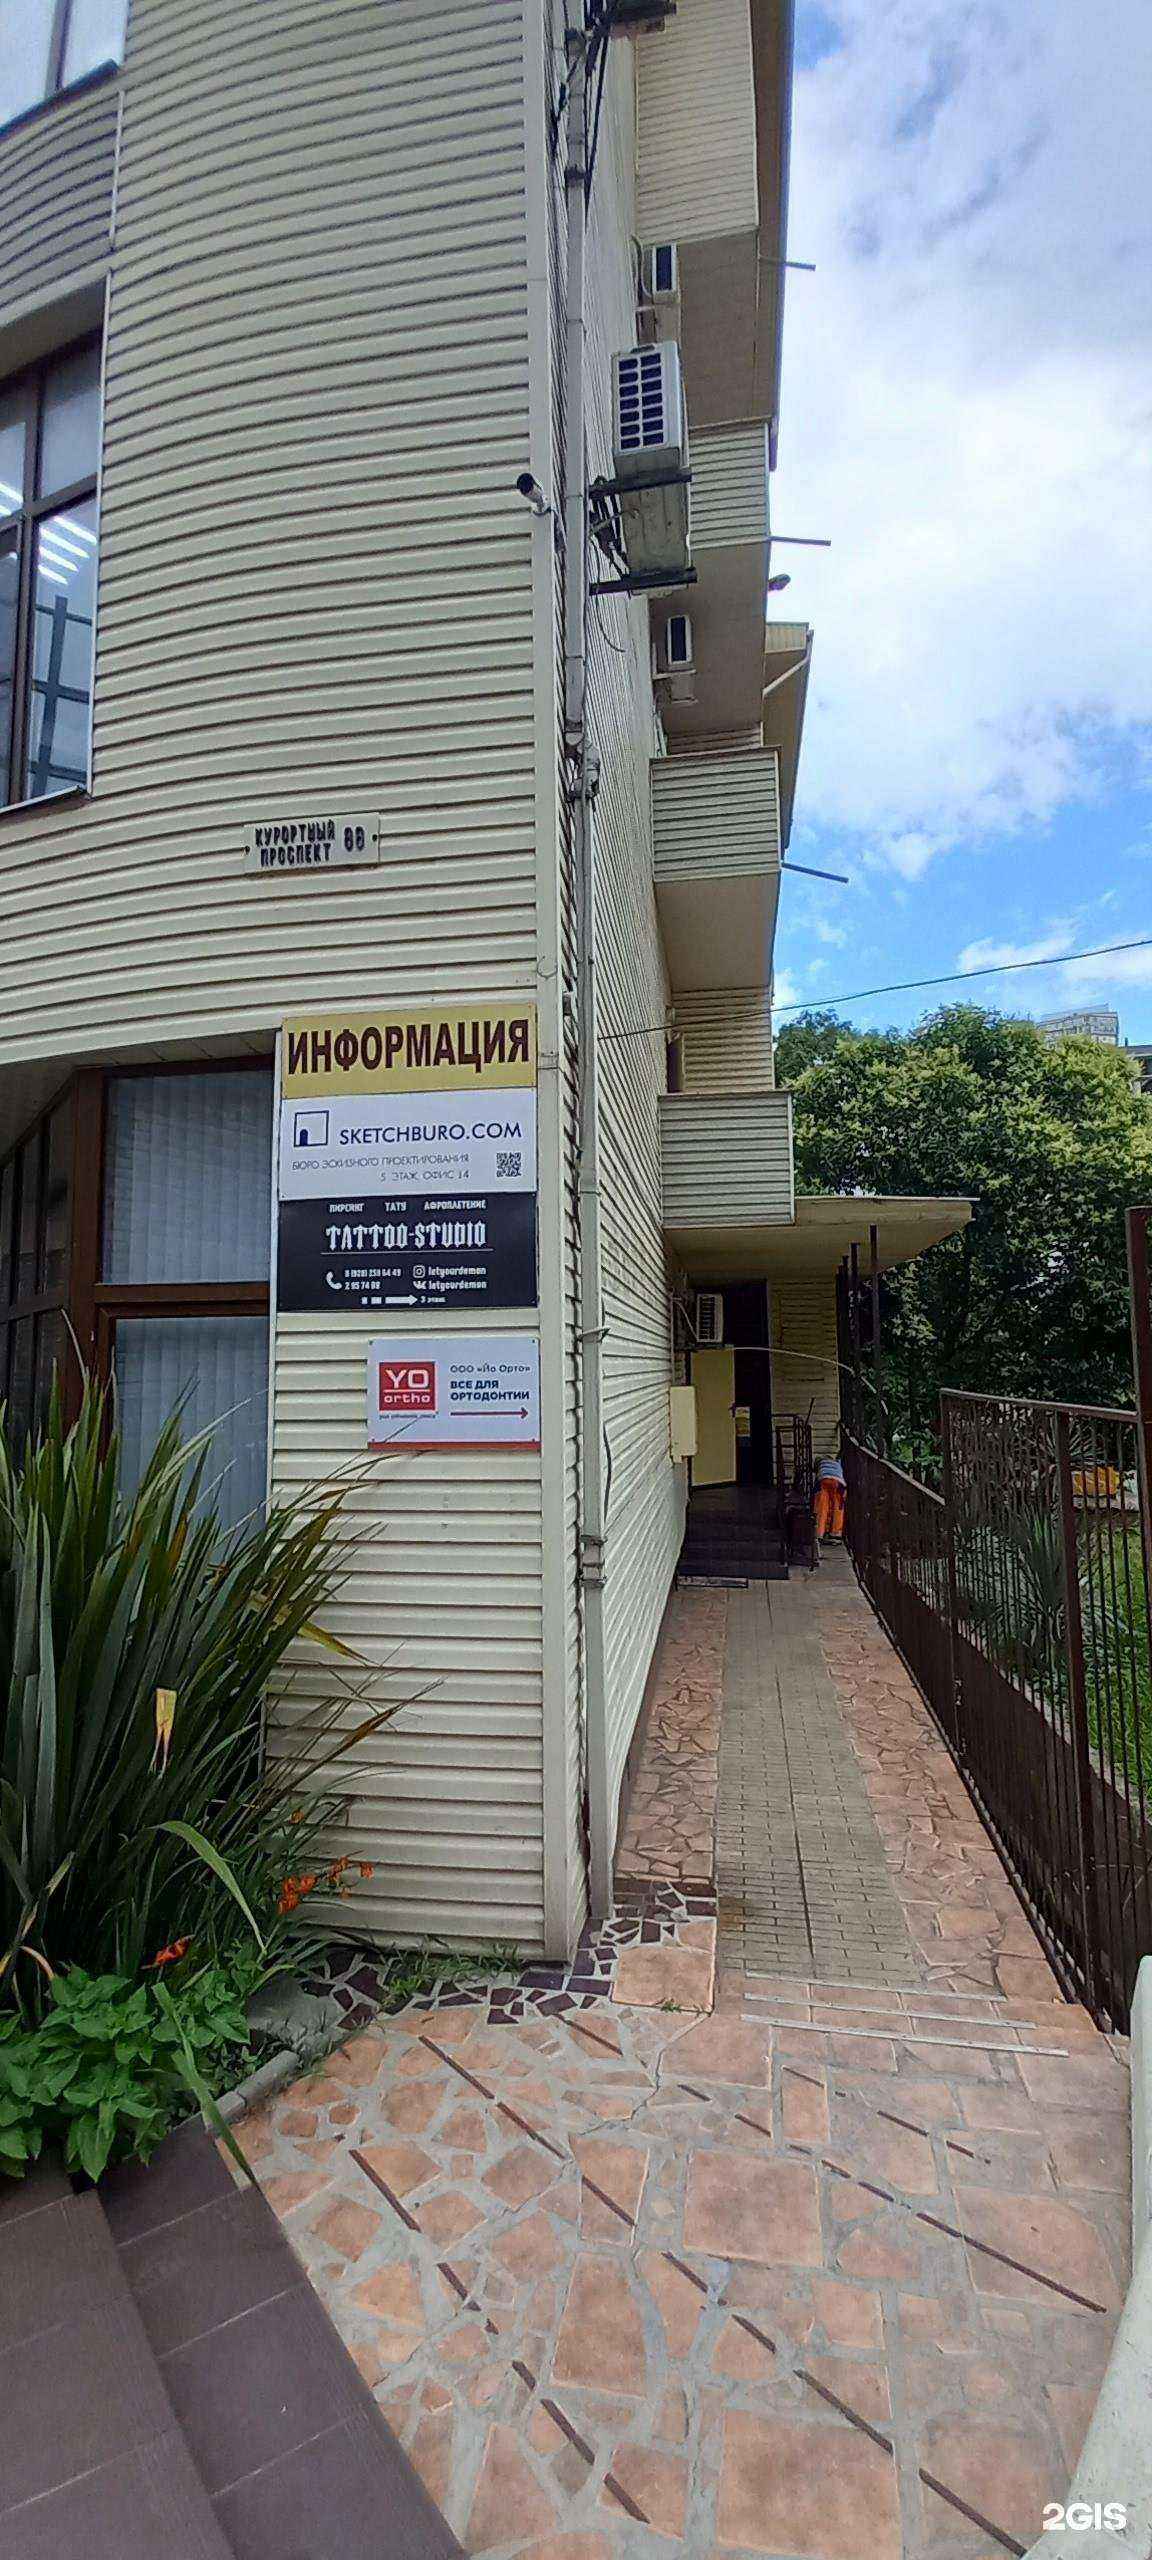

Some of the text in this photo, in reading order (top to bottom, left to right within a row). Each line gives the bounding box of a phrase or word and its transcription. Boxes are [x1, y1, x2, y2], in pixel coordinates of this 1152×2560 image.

[255, 819, 336, 847] КУРОРТНЫЙ
[260, 843, 331, 867] ПРОСПЕКТ
[288, 1018, 530, 1075] ИНФОРМАЦИЯ
[339, 1122, 522, 1146] SKETCHBURO.COM
[292, 1153, 469, 1171] БЮРО ЭСКИЗНОГО ПРОЕКТИРОВАНИЯ
[423, 1170, 454, 1180] ОФИС
[458, 1170, 469, 1179] 14
[329, 1203, 364, 1213] ПИРСИНГ
[385, 1202, 406, 1212] ТАТУ
[325, 1220, 487, 1250] TATTOO-STUDIO
[450, 1364, 474, 1373] ООО
[499, 1364, 531, 1374] Орто»
[385, 1369, 430, 1389] YO
[450, 1380, 499, 1390] ВСЕ ДЛЯ
[383, 1392, 432, 1404] ortho
[450, 1391, 530, 1402] ОРТОДОНТИИ
